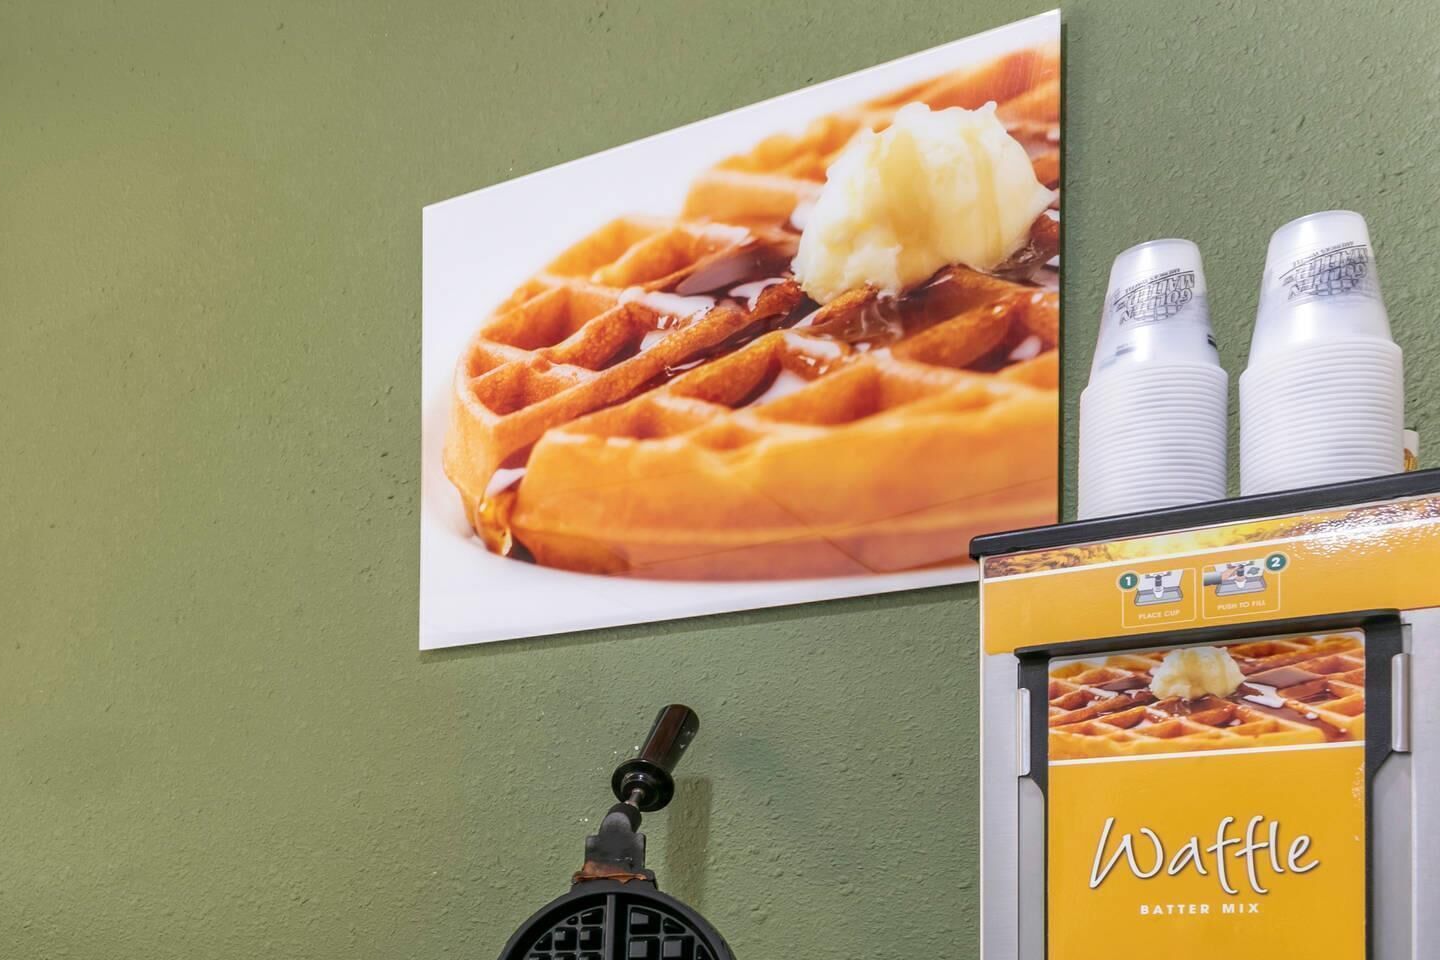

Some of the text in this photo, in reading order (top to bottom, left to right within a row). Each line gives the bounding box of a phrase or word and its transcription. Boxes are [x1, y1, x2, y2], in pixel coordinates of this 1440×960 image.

[1271, 557, 1280, 567] 2
[1125, 576, 1131, 586] 1
[1217, 599, 1266, 611] PUSH TO FILL
[1138, 609, 1180, 620] PLACE CUP
[1088, 815, 1320, 895] Waffle
[1140, 903, 1259, 915] BATTER MIX
